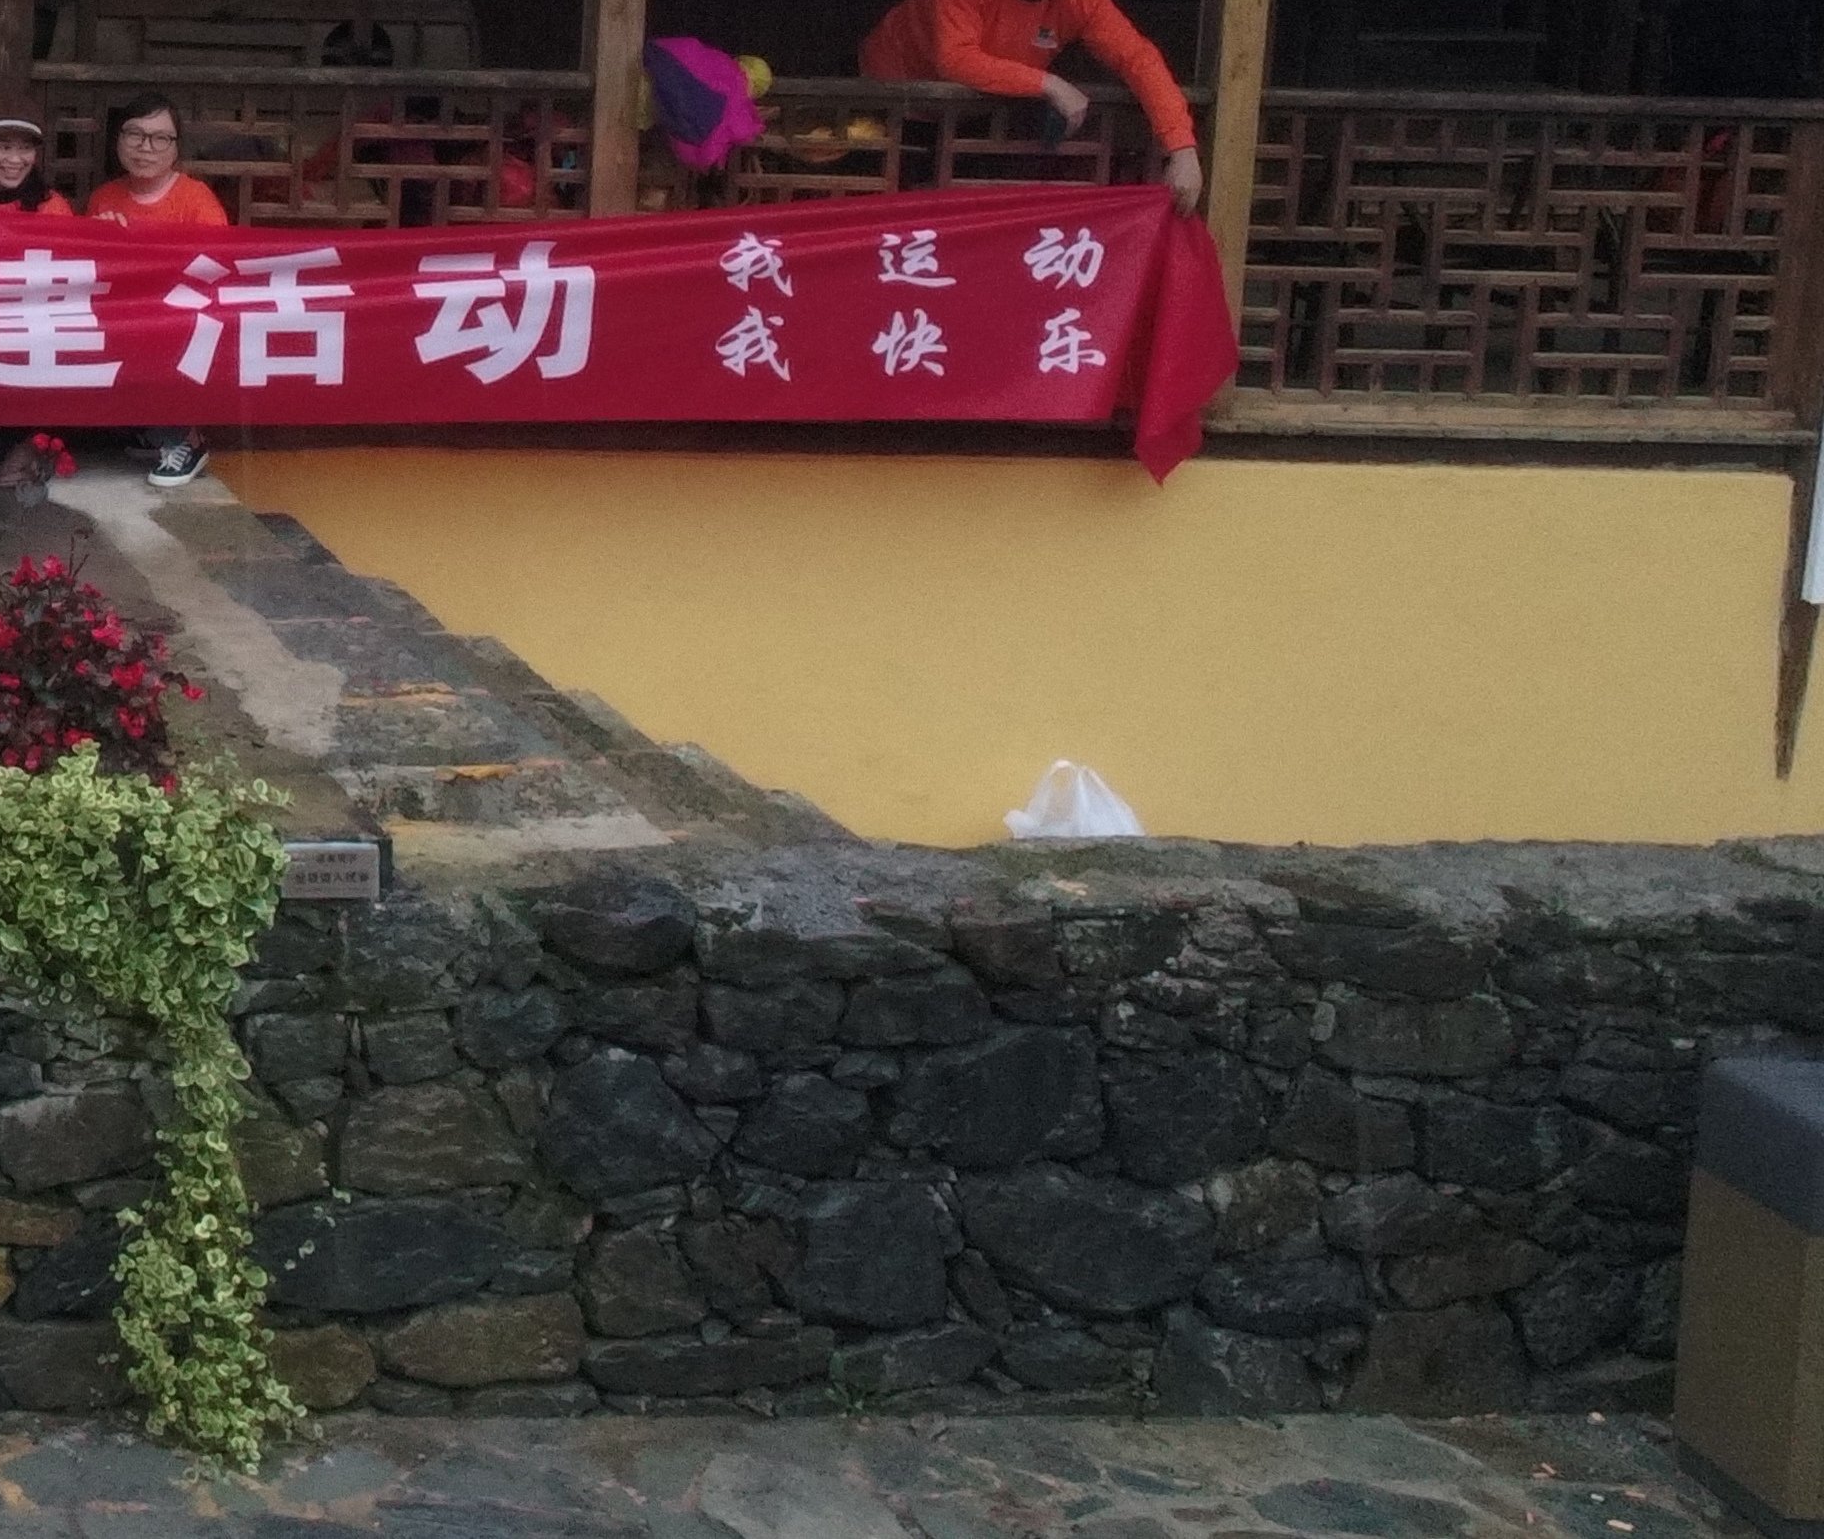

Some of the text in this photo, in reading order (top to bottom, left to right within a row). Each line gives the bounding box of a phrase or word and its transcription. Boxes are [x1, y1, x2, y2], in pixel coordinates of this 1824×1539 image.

[719, 227, 1104, 297] 我运动
[715, 305, 1107, 381] 我快乐
